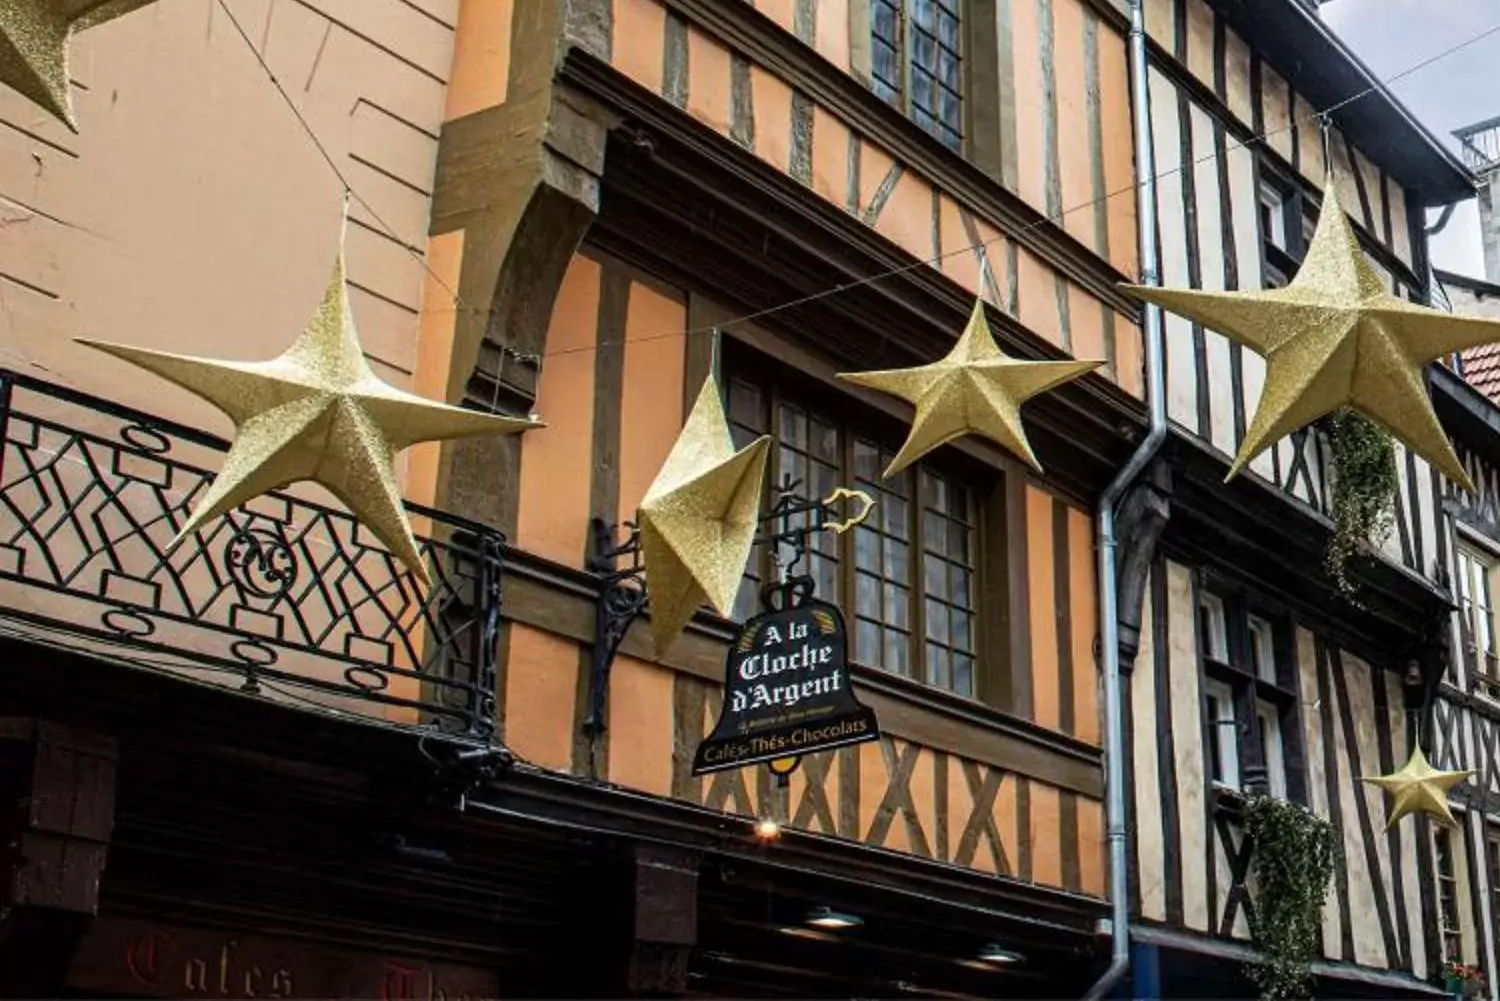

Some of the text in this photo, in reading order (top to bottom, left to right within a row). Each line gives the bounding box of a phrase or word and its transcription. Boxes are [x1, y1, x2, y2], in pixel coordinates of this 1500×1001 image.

[764, 622, 808, 646] A la
[740, 643, 833, 680] Cloche
[731, 669, 842, 712] d'Argent
